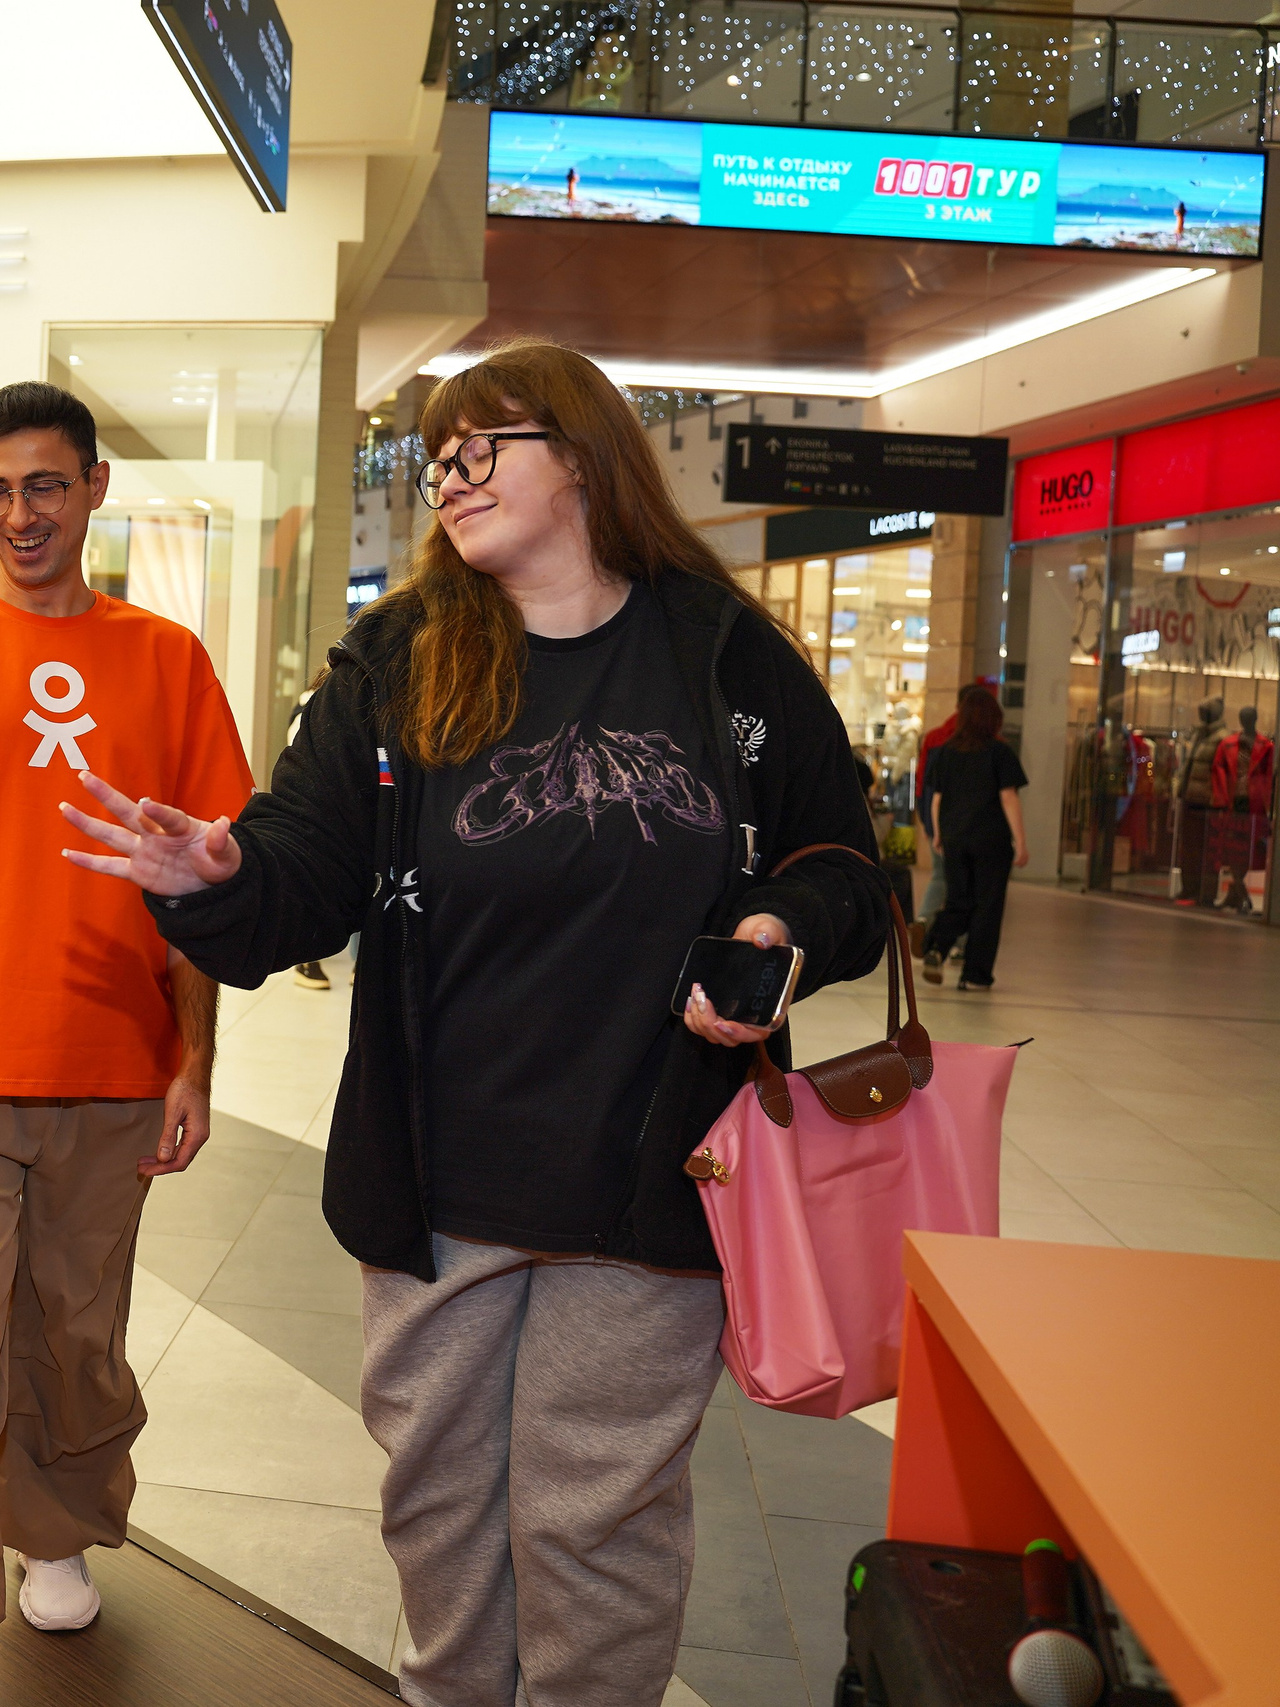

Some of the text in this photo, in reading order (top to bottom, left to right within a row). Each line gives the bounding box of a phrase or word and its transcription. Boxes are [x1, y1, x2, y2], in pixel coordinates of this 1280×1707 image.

[713, 153, 853, 175] ПУТЬ К ОТДЫХУ
[723, 172, 841, 191] НАЧИНАЕТСЯ
[753, 191, 810, 207] ЗДЕСЬ
[924, 204, 992, 222] 3 ЭТАЖ
[735, 436, 751, 470] 1
[1040, 470, 1094, 505] HUGO
[869, 511, 918, 536] LACOSTE
[1128, 605, 1196, 645] HUGO
